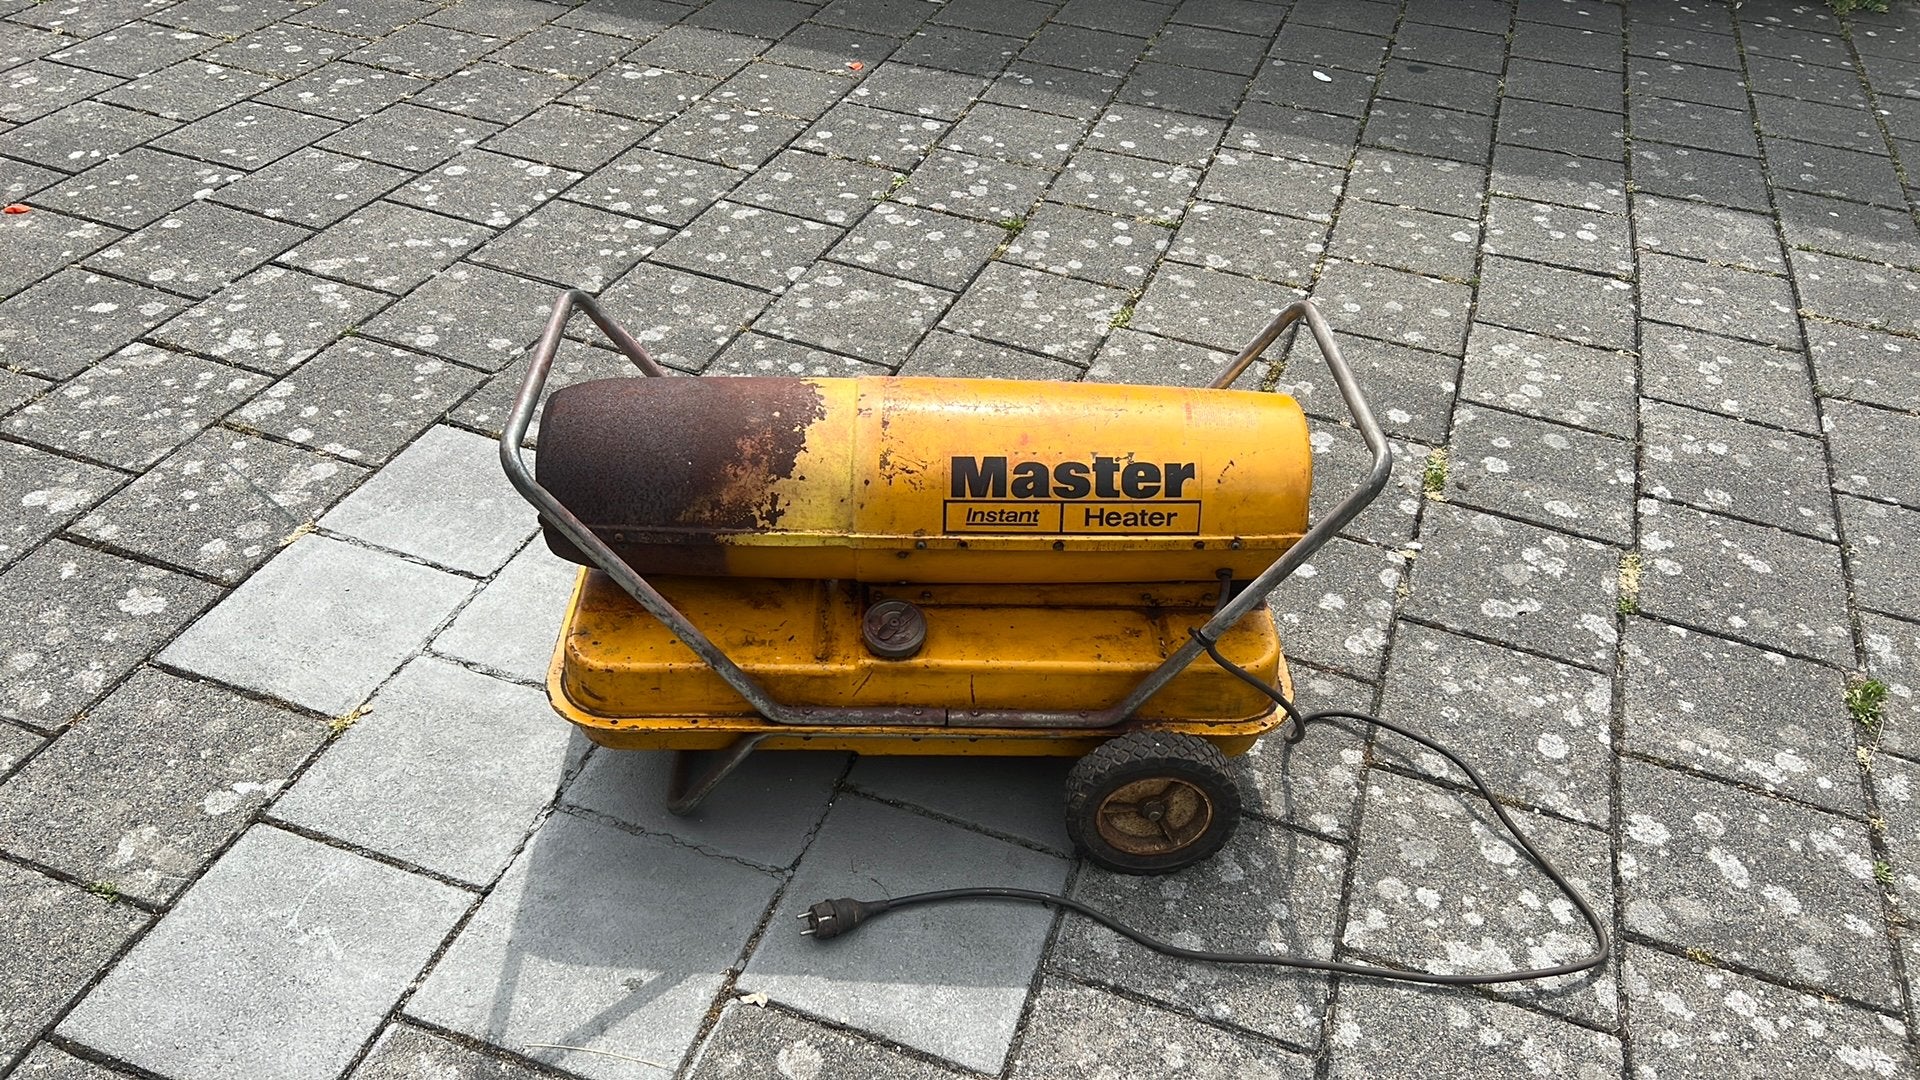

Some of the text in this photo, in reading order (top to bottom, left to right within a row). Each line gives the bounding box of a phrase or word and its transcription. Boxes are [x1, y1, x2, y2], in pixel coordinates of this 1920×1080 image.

[951, 456, 1195, 499] Master
[966, 508, 1178, 527] Instant Heater
